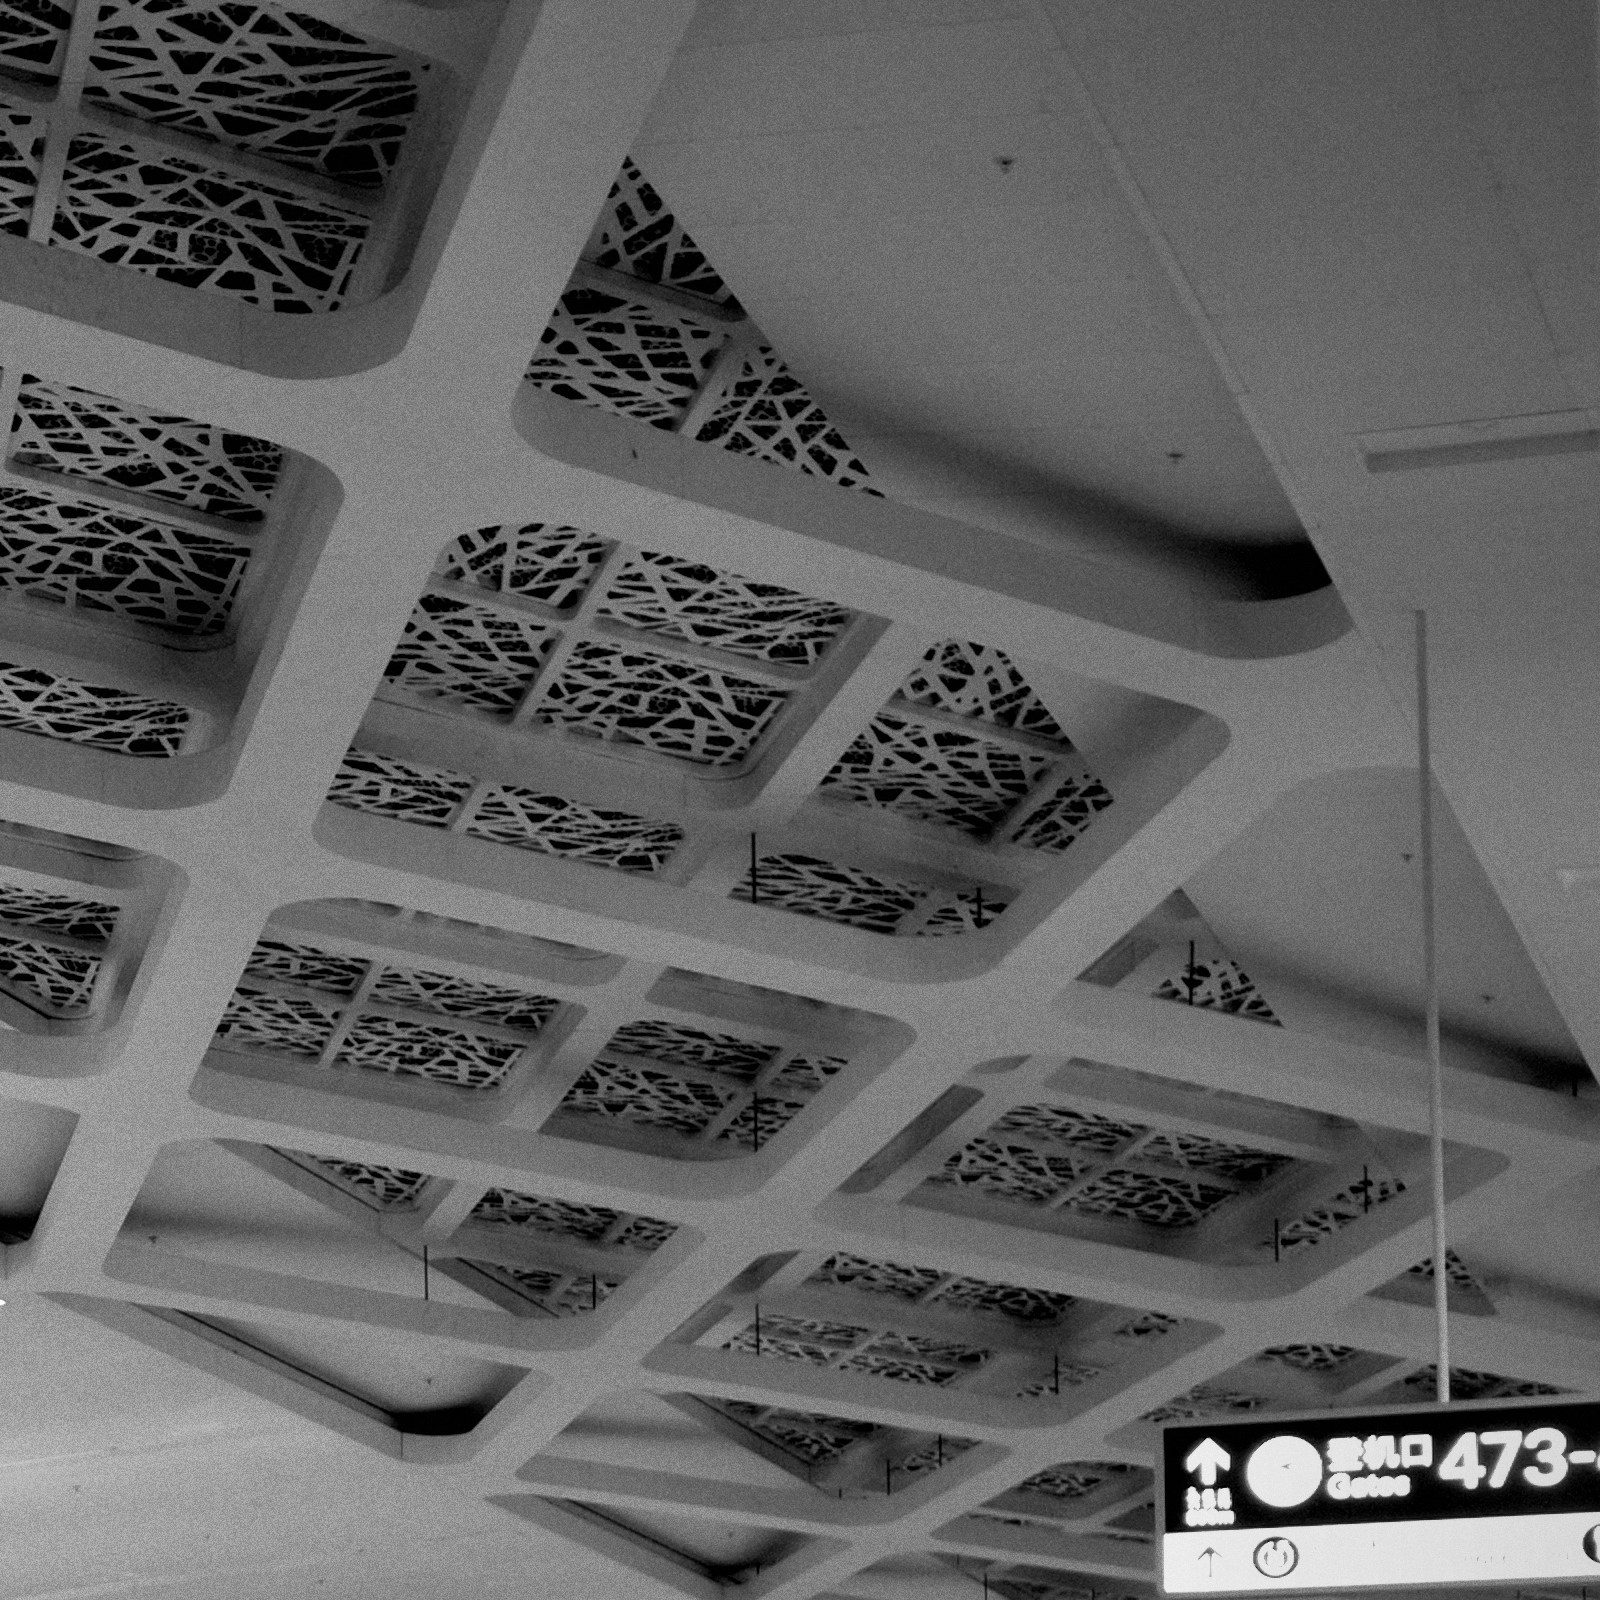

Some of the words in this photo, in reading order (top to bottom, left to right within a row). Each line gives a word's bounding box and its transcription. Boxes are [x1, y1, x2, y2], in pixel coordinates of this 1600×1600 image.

[1327, 1433, 1433, 1473] 登机口
[1439, 1427, 1600, 1490] 473-
[1326, 1473, 1412, 1500] Gates
